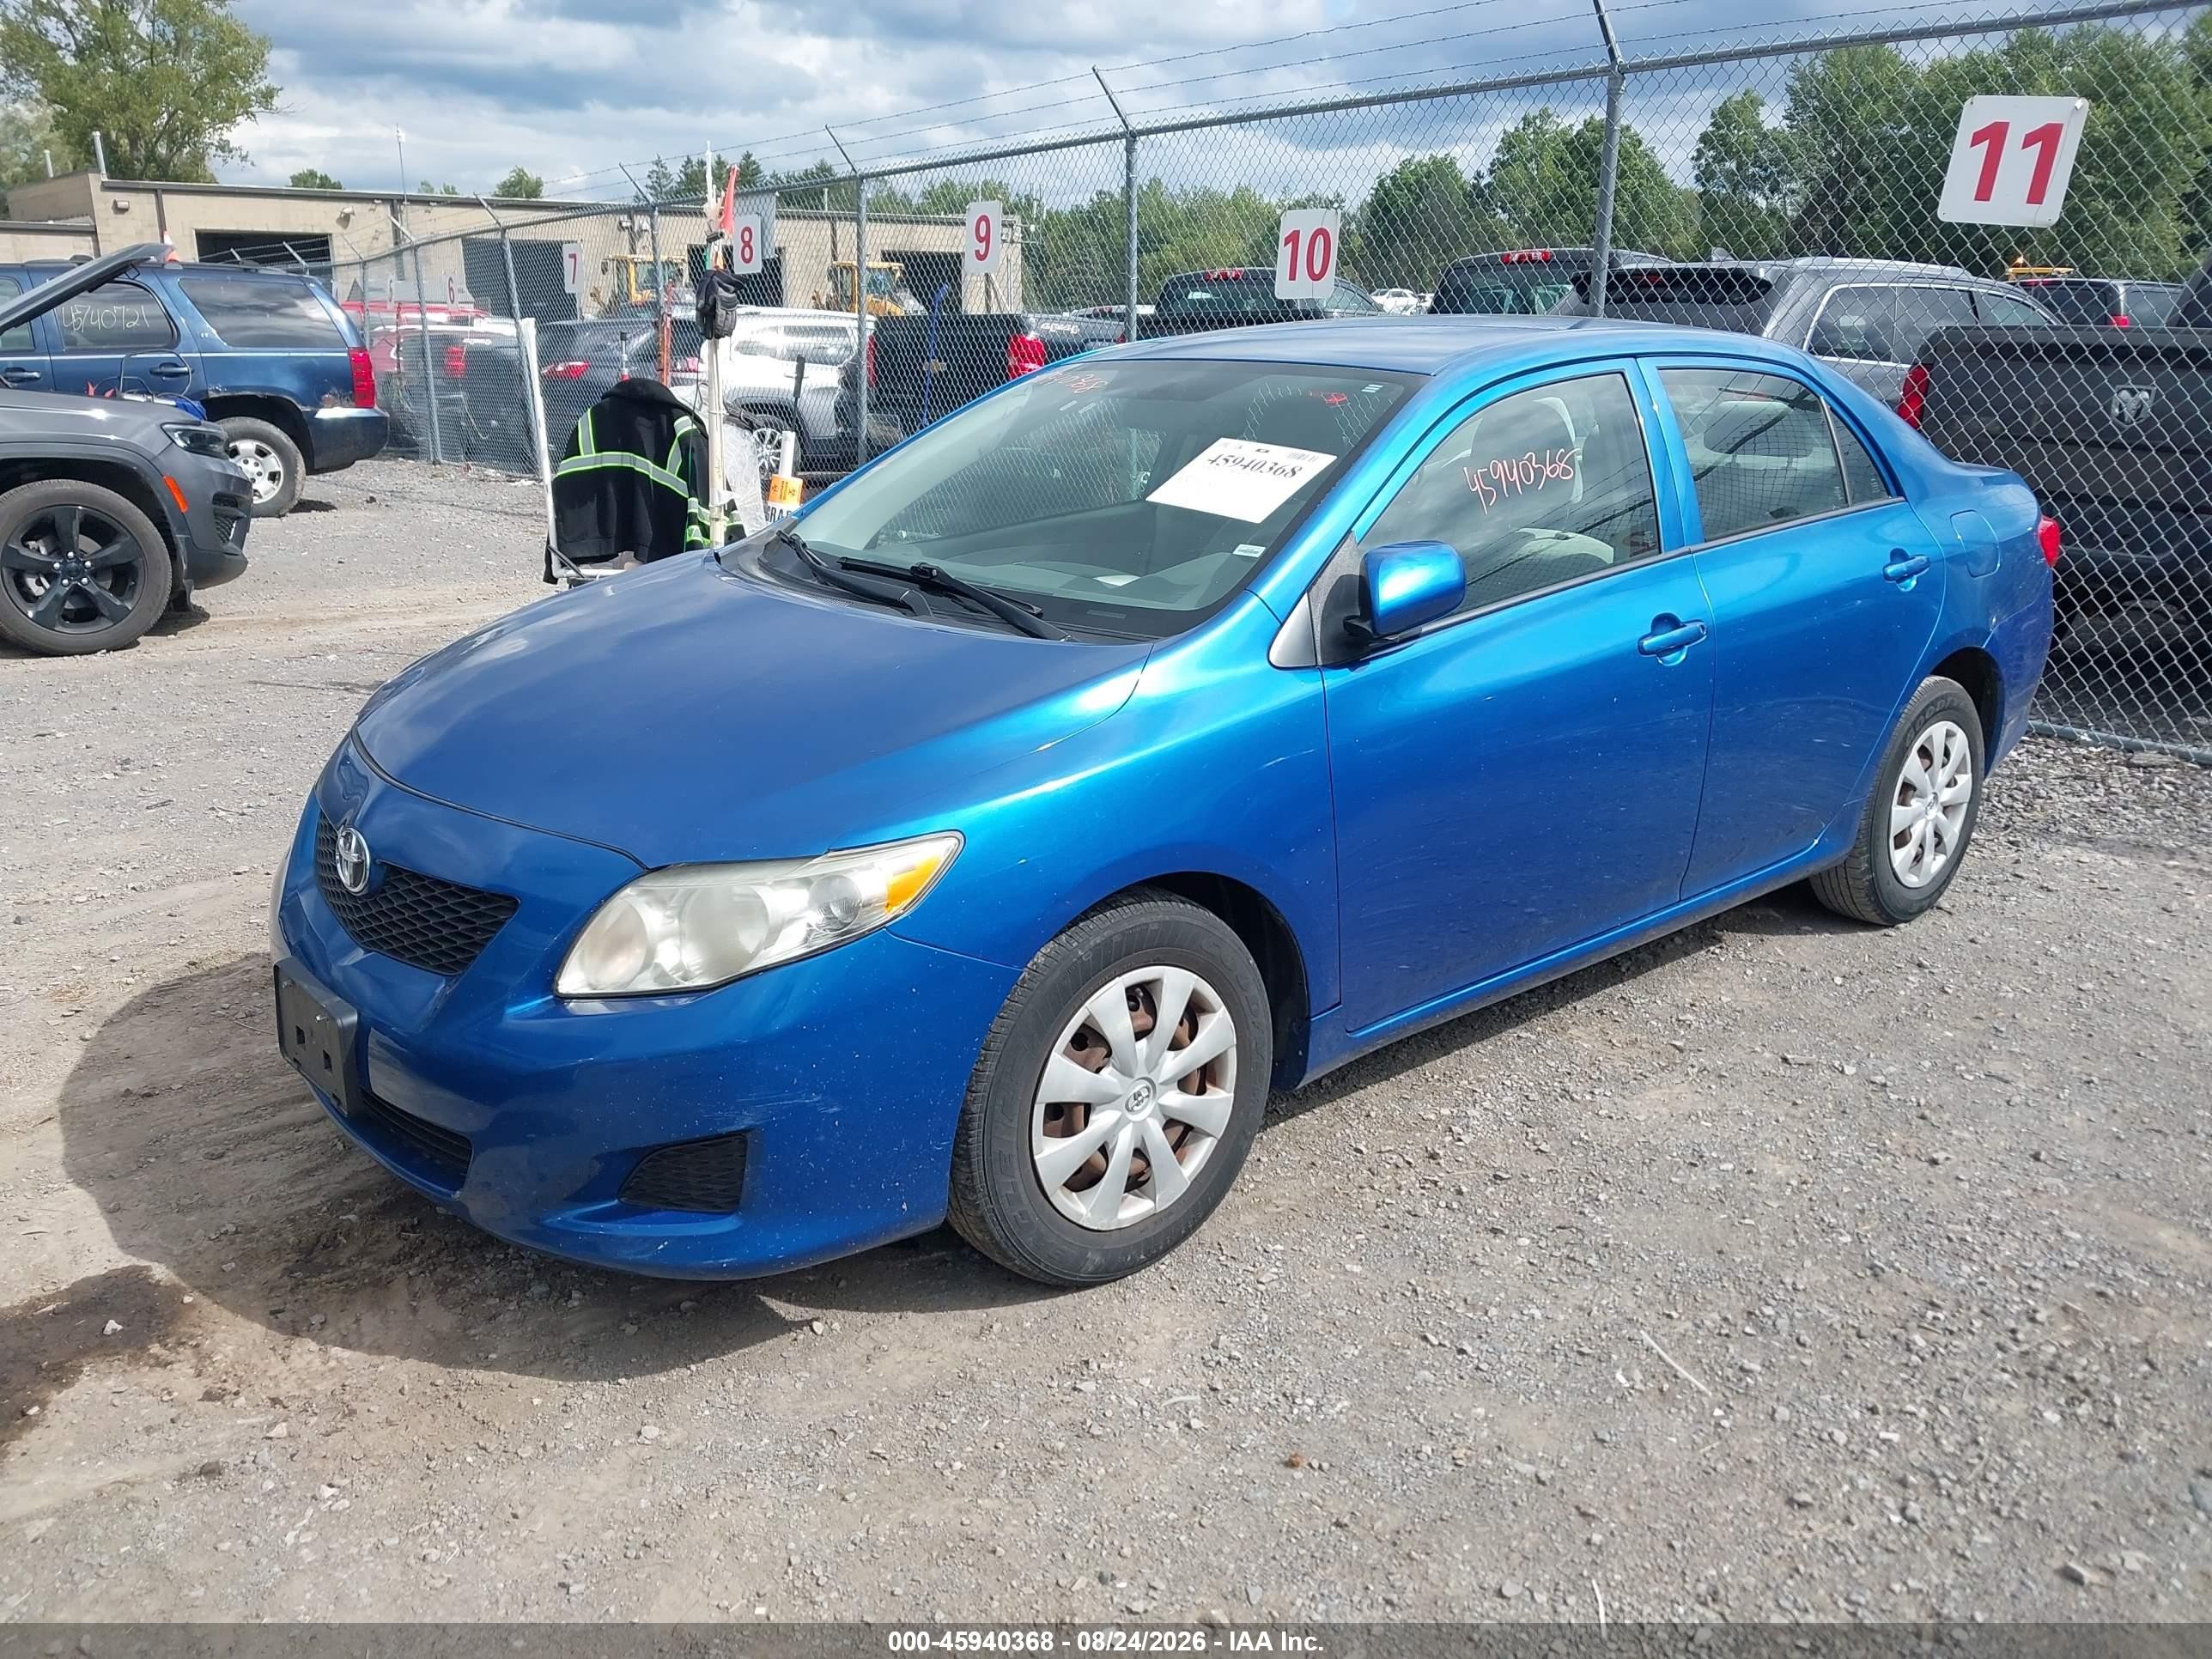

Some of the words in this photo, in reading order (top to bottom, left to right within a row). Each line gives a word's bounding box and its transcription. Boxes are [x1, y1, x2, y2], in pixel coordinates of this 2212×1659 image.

[1969, 120, 2064, 205] 11
[740, 226, 754, 264] 8
[974, 214, 991, 262] 9
[1283, 227, 1332, 282] 10
[447, 276, 455, 304] 6
[568, 252, 578, 285] 7
[1207, 453, 1303, 478] 45940368
[1463, 447, 1580, 515] 45940368
